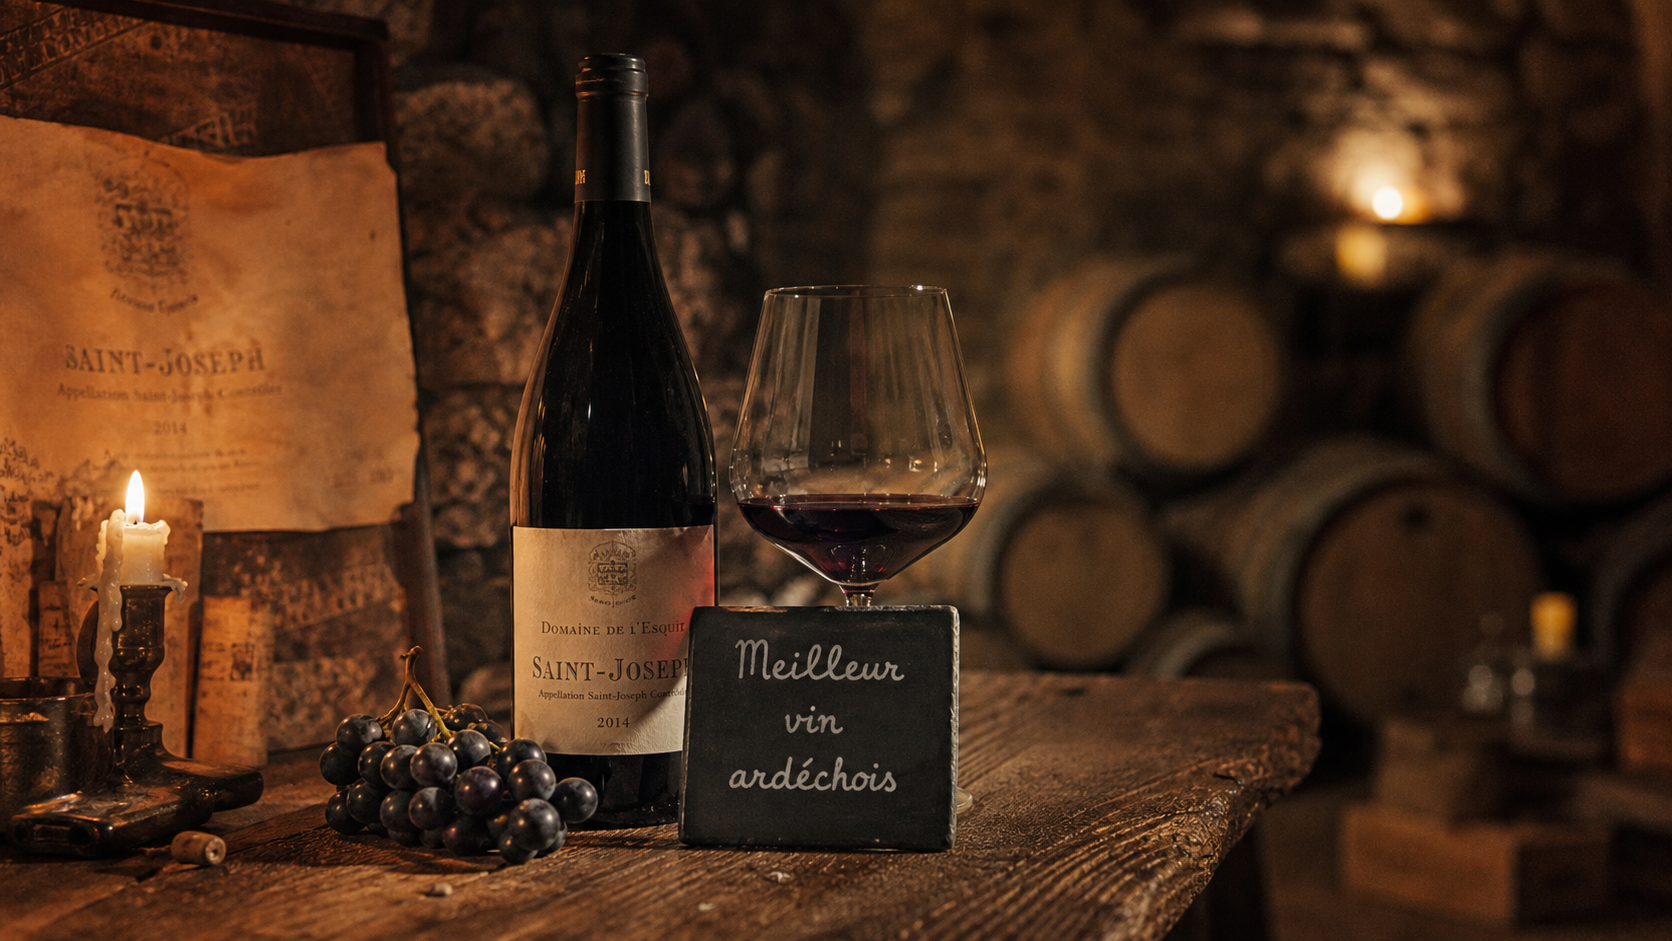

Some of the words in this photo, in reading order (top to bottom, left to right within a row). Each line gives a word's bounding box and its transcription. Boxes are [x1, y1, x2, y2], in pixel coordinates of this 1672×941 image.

[65, 345, 267, 377] SAINT-JOSEPH
[153, 420, 188, 436] 2014
[734, 638, 905, 681] Meilleur
[538, 689, 585, 701] Appellation
[588, 690, 647, 702] Saint-Joseph
[596, 716, 630, 729] 2014
[784, 705, 844, 734] vin
[728, 756, 898, 793] ardéchois
